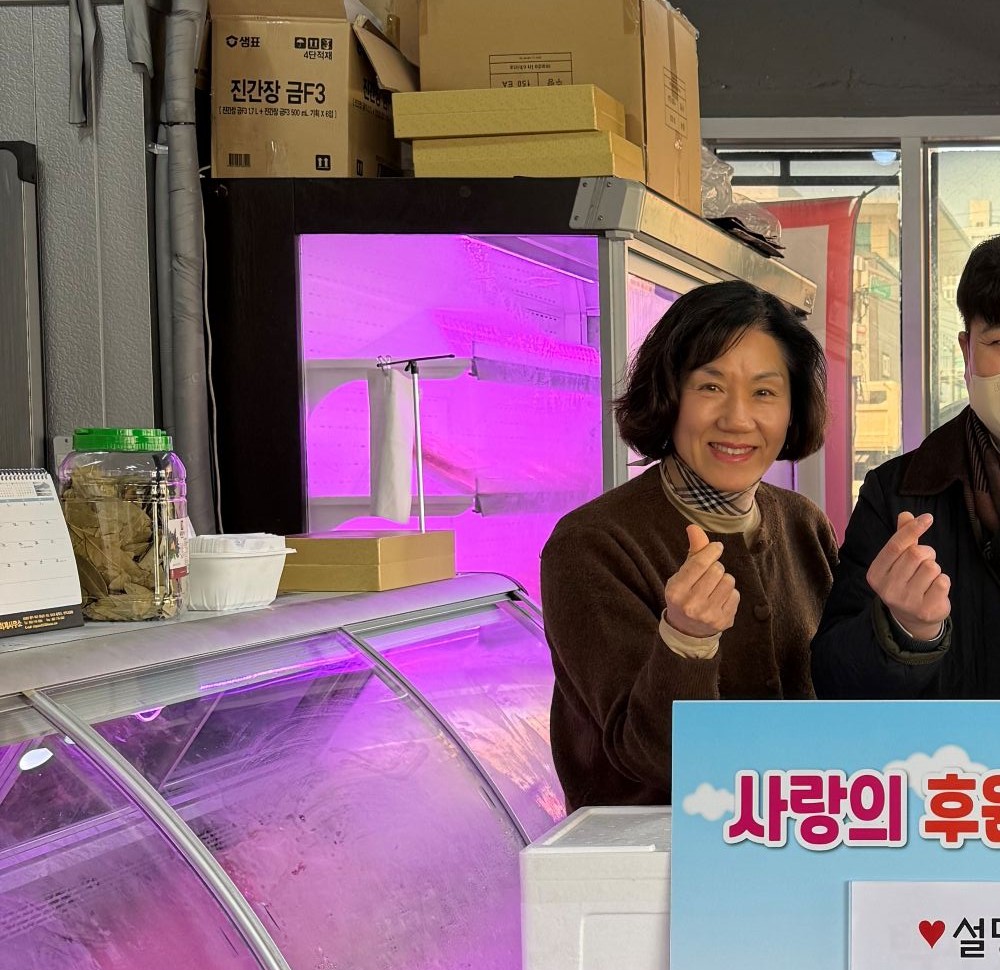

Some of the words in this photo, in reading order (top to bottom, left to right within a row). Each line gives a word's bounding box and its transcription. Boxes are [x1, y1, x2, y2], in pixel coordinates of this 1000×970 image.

[239, 36, 261, 48] 샘표
[303, 50, 333, 61] 4단적재
[230, 78, 281, 104] 진간장
[285, 80, 326, 105] 금F3
[726, 771, 904, 850] 사랑의
